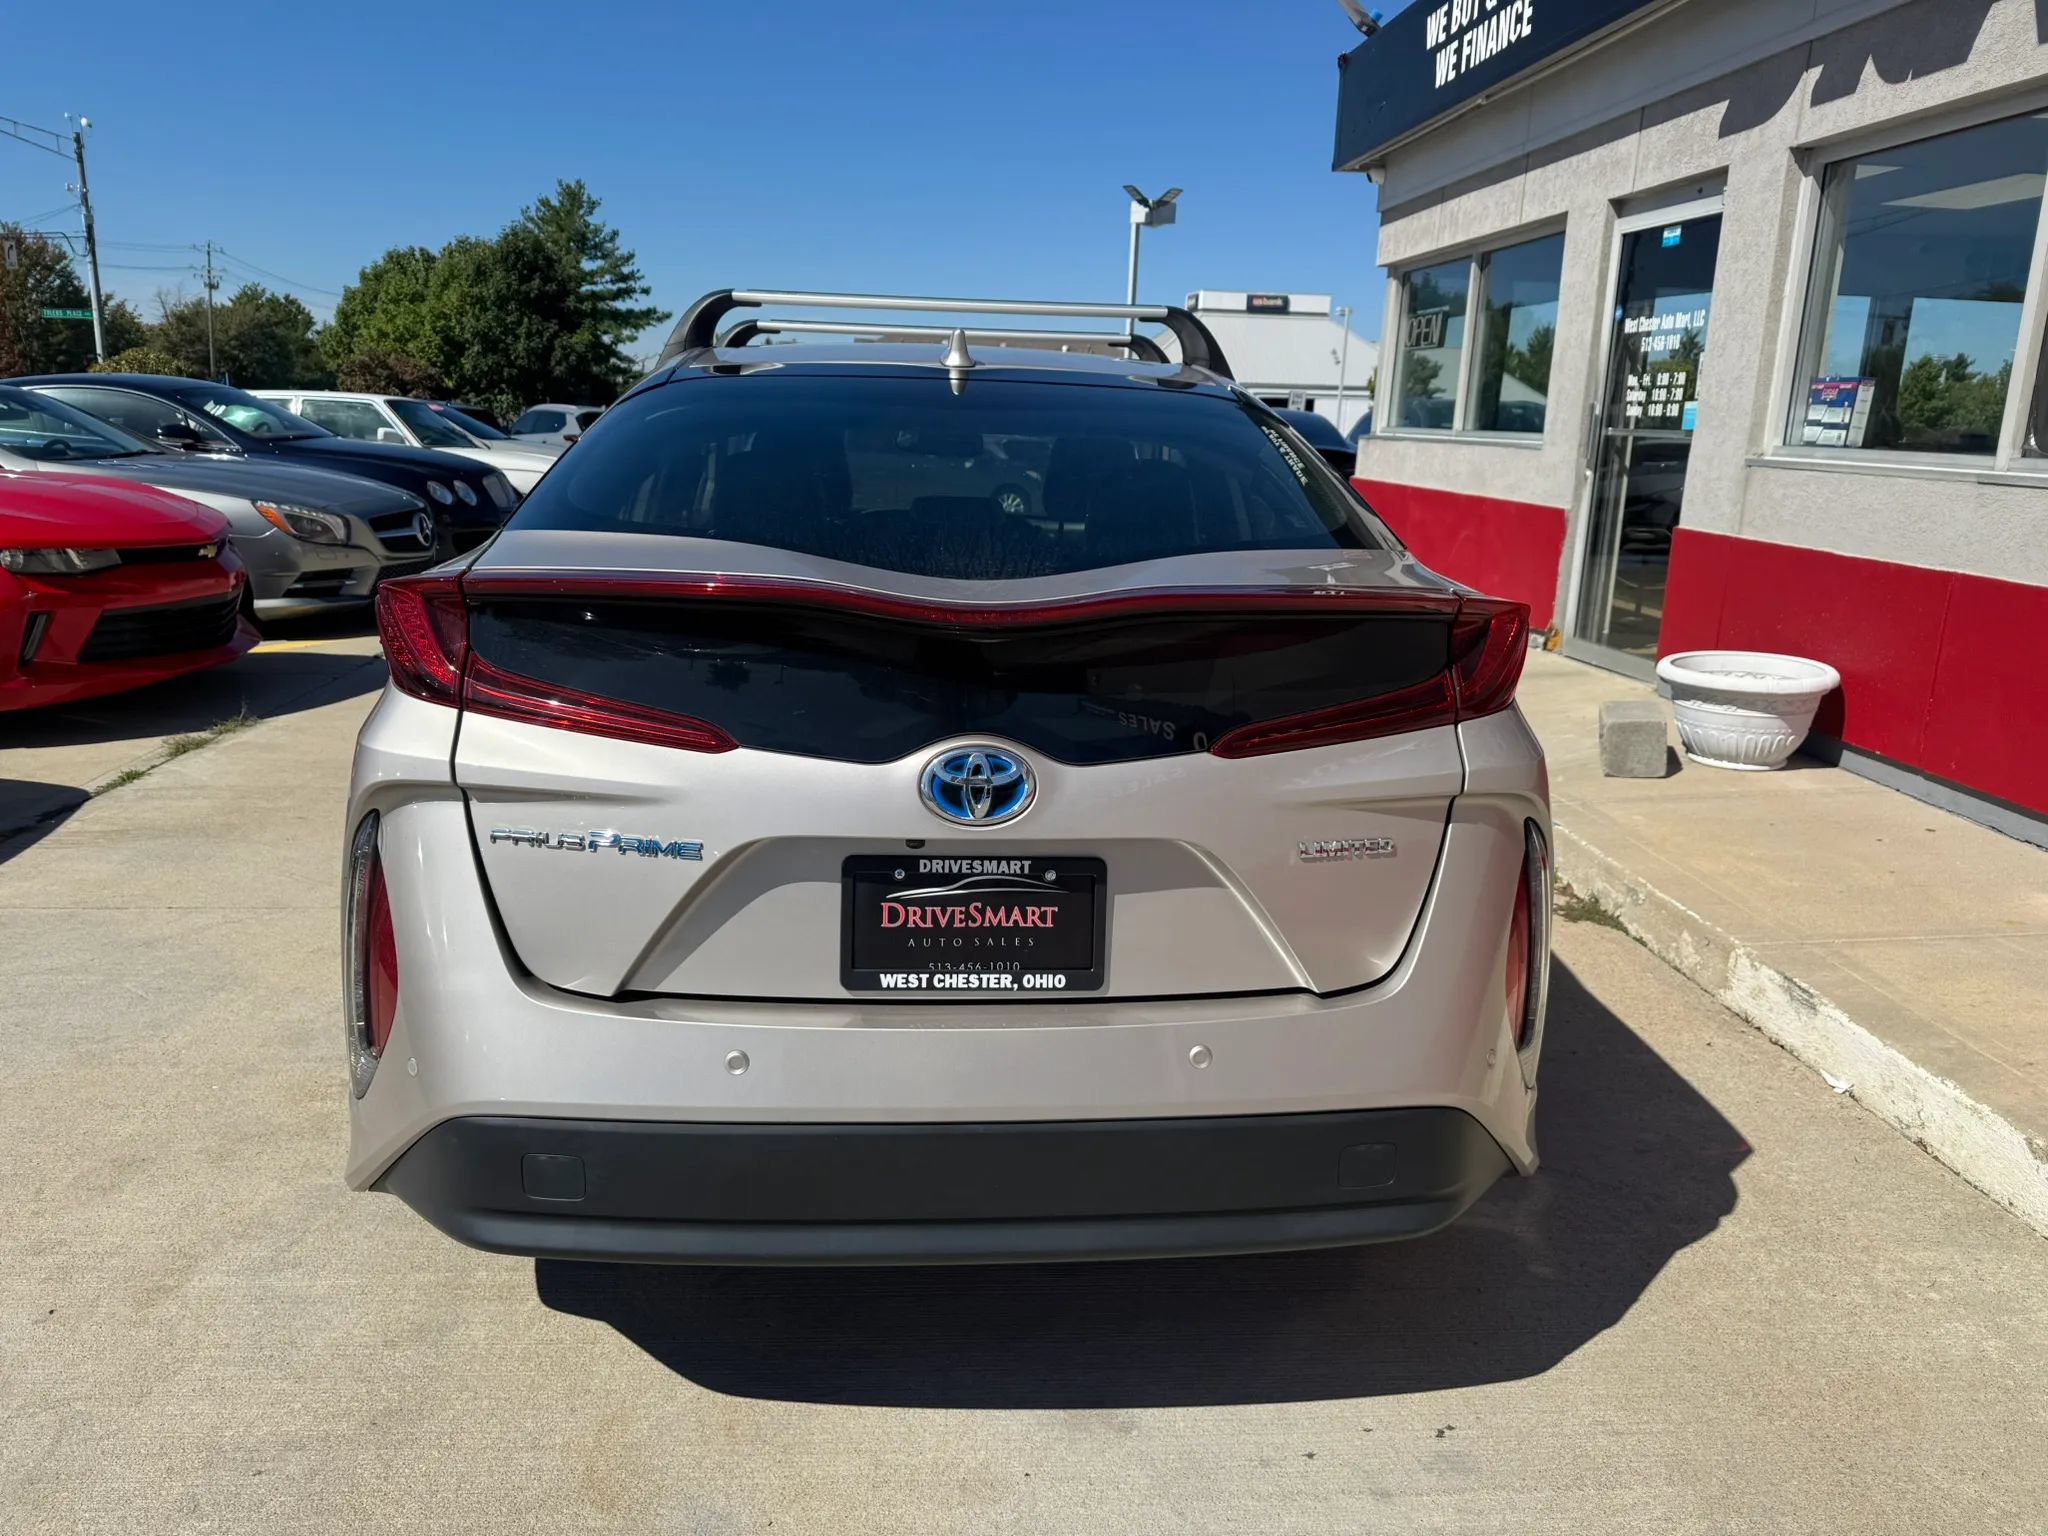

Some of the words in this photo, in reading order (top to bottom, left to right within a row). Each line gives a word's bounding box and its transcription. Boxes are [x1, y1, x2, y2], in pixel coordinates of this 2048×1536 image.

[1426, 2, 1449, 51] WE
[1435, 39, 1459, 89] WE
[1461, 0, 1533, 74] FINANCE
[1405, 312, 1443, 347] OPEN
[1624, 317, 1639, 334] West
[1639, 315, 1661, 332] Chester
[1661, 313, 1675, 330] Auto
[1693, 309, 1706, 327] LLC
[1118, 711, 1176, 741] SALES
[490, 827, 586, 851] PRIUS
[587, 829, 704, 861] PRIME
[1299, 838, 1394, 861] LIMITED
[919, 859, 1032, 875] DRIVESMART
[907, 937, 963, 948] AUTO
[974, 937, 1035, 948] SALES
[928, 961, 1020, 972] 513-456-1010
[879, 973, 929, 989] WEST
[932, 973, 1019, 992] CHESTER,
[1022, 974, 1067, 989] OHIO
